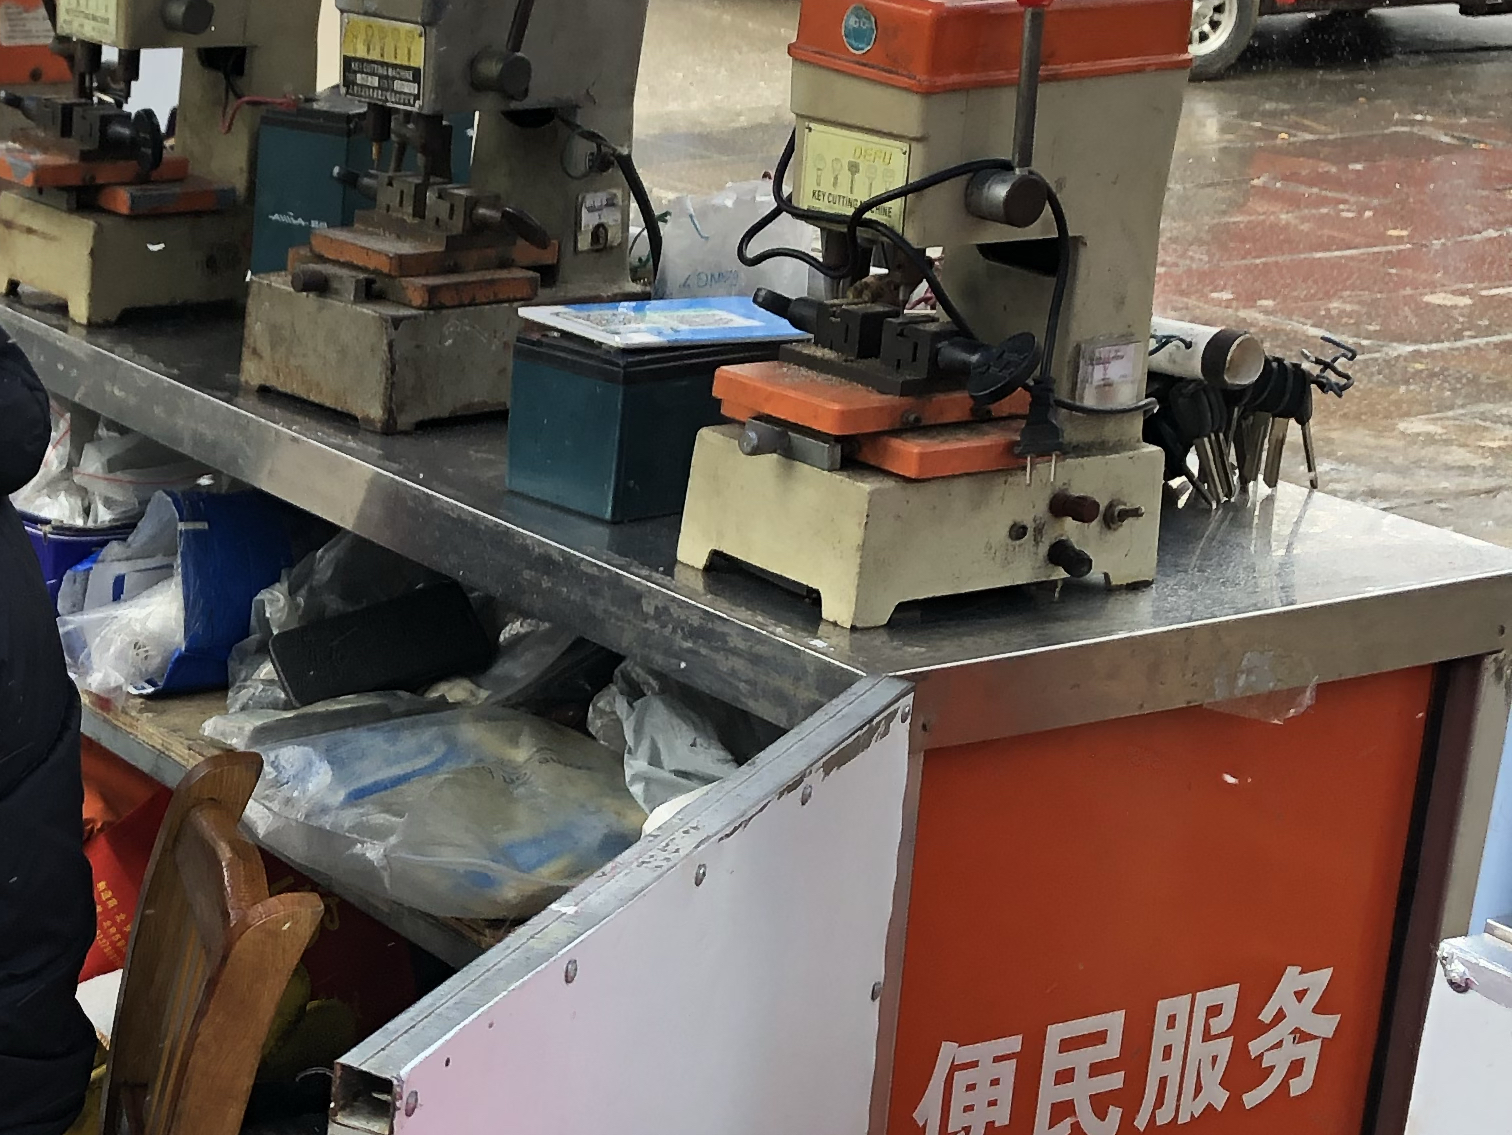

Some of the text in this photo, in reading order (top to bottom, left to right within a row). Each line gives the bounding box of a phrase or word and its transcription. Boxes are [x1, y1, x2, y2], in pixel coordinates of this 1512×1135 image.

[811, 189, 828, 202] KEY
[827, 192, 859, 208] CUTTING
[912, 965, 1342, 1135] 便民服务
